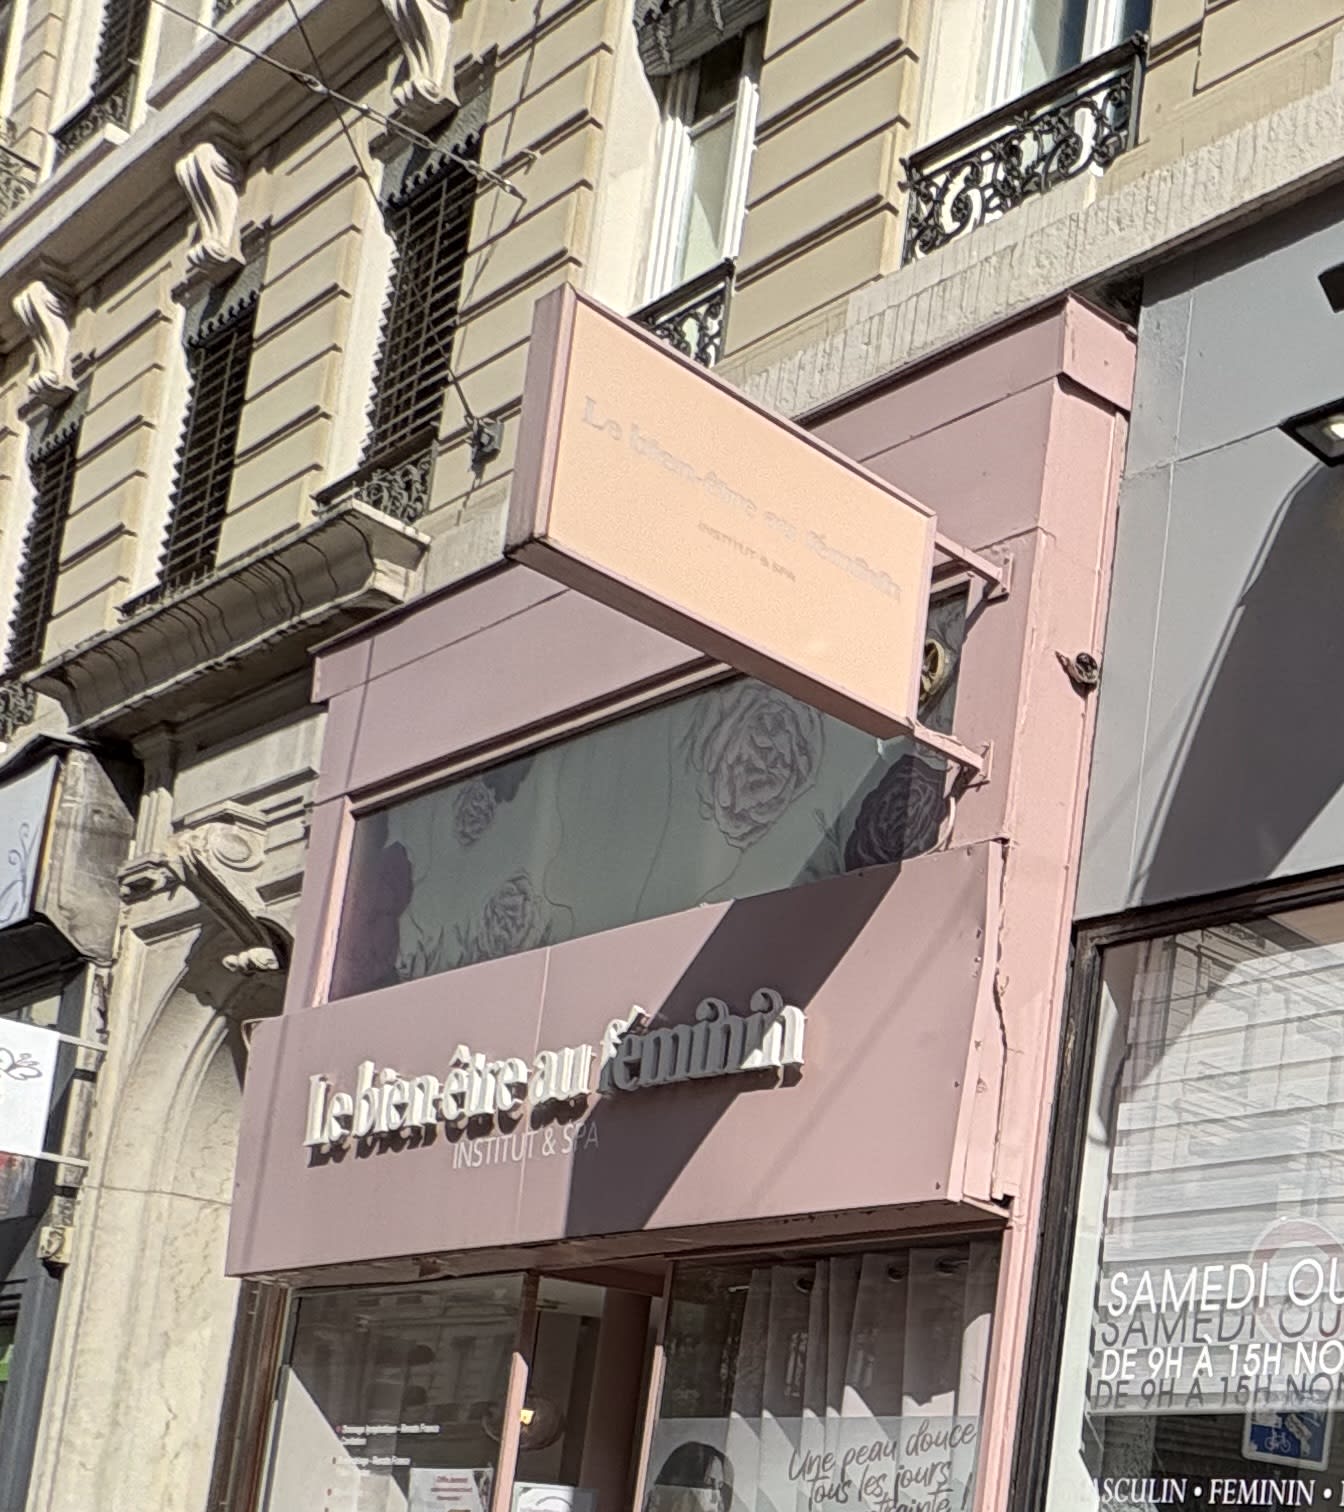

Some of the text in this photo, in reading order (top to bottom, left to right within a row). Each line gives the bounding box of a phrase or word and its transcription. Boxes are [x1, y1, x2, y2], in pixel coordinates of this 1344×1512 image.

[529, 1043, 597, 1105] au
[452, 1121, 600, 1170] INSTITUT & SPA
[1107, 1261, 1269, 1318] SAMEDI
[1100, 1348, 1138, 1381] DE
[1147, 1346, 1184, 1379] 9H
[1192, 1334, 1214, 1378] À
[1228, 1343, 1282, 1377] 15H
[788, 1418, 977, 1484] Une peau douce
[858, 1464, 887, 1502] les
[893, 1460, 953, 1506] jours
[1208, 1478, 1316, 1506] FEMININ
